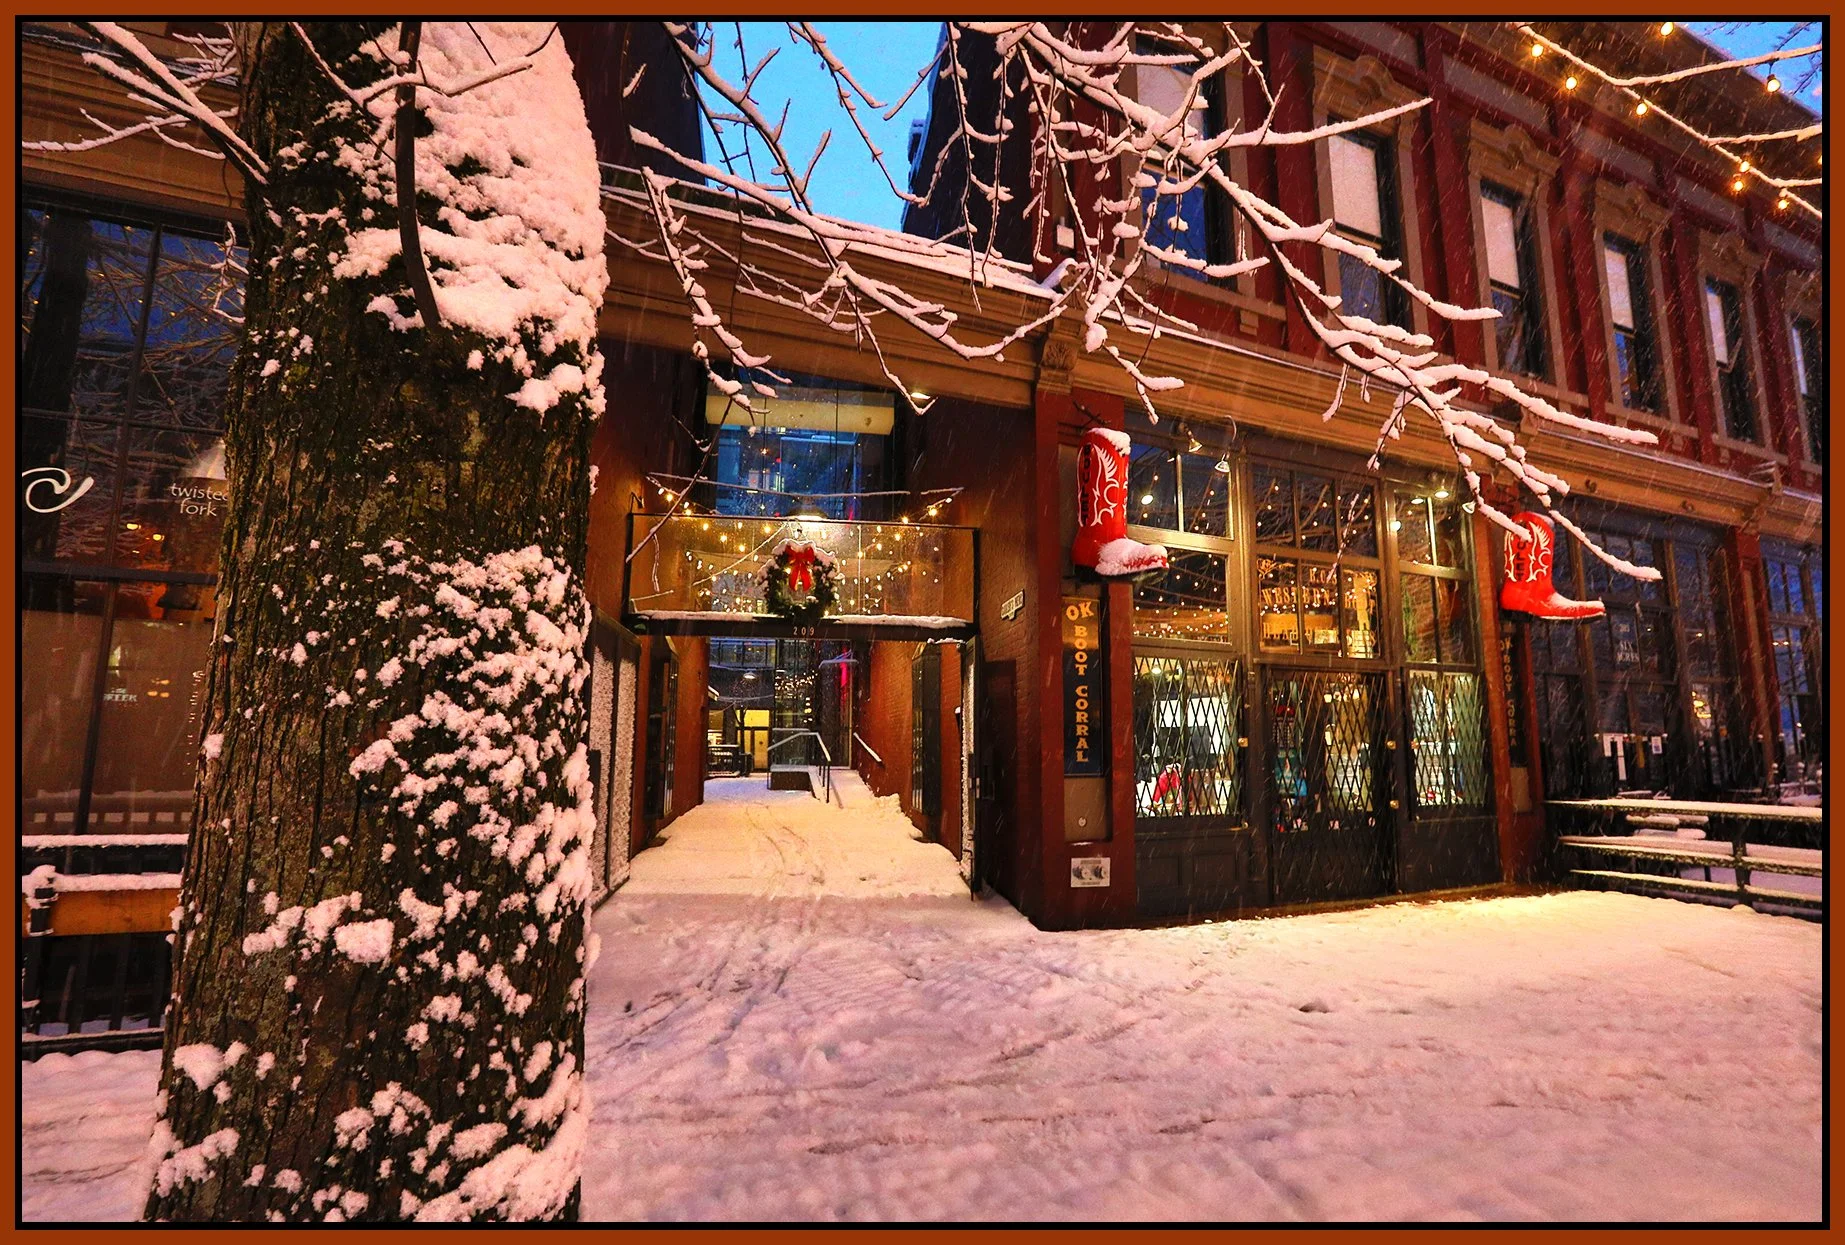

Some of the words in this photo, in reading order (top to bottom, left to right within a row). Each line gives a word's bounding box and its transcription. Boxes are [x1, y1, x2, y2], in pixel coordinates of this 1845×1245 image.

[1081, 443, 1092, 526] BOULET
[180, 498, 217, 516] fork
[1262, 587, 1331, 606] WESTERN
[1066, 601, 1094, 621] OK
[793, 626, 815, 636] 209
[1074, 625, 1088, 676] BOOT
[1503, 654, 1513, 691] BOOT
[1075, 686, 1089, 762] CORRAL
